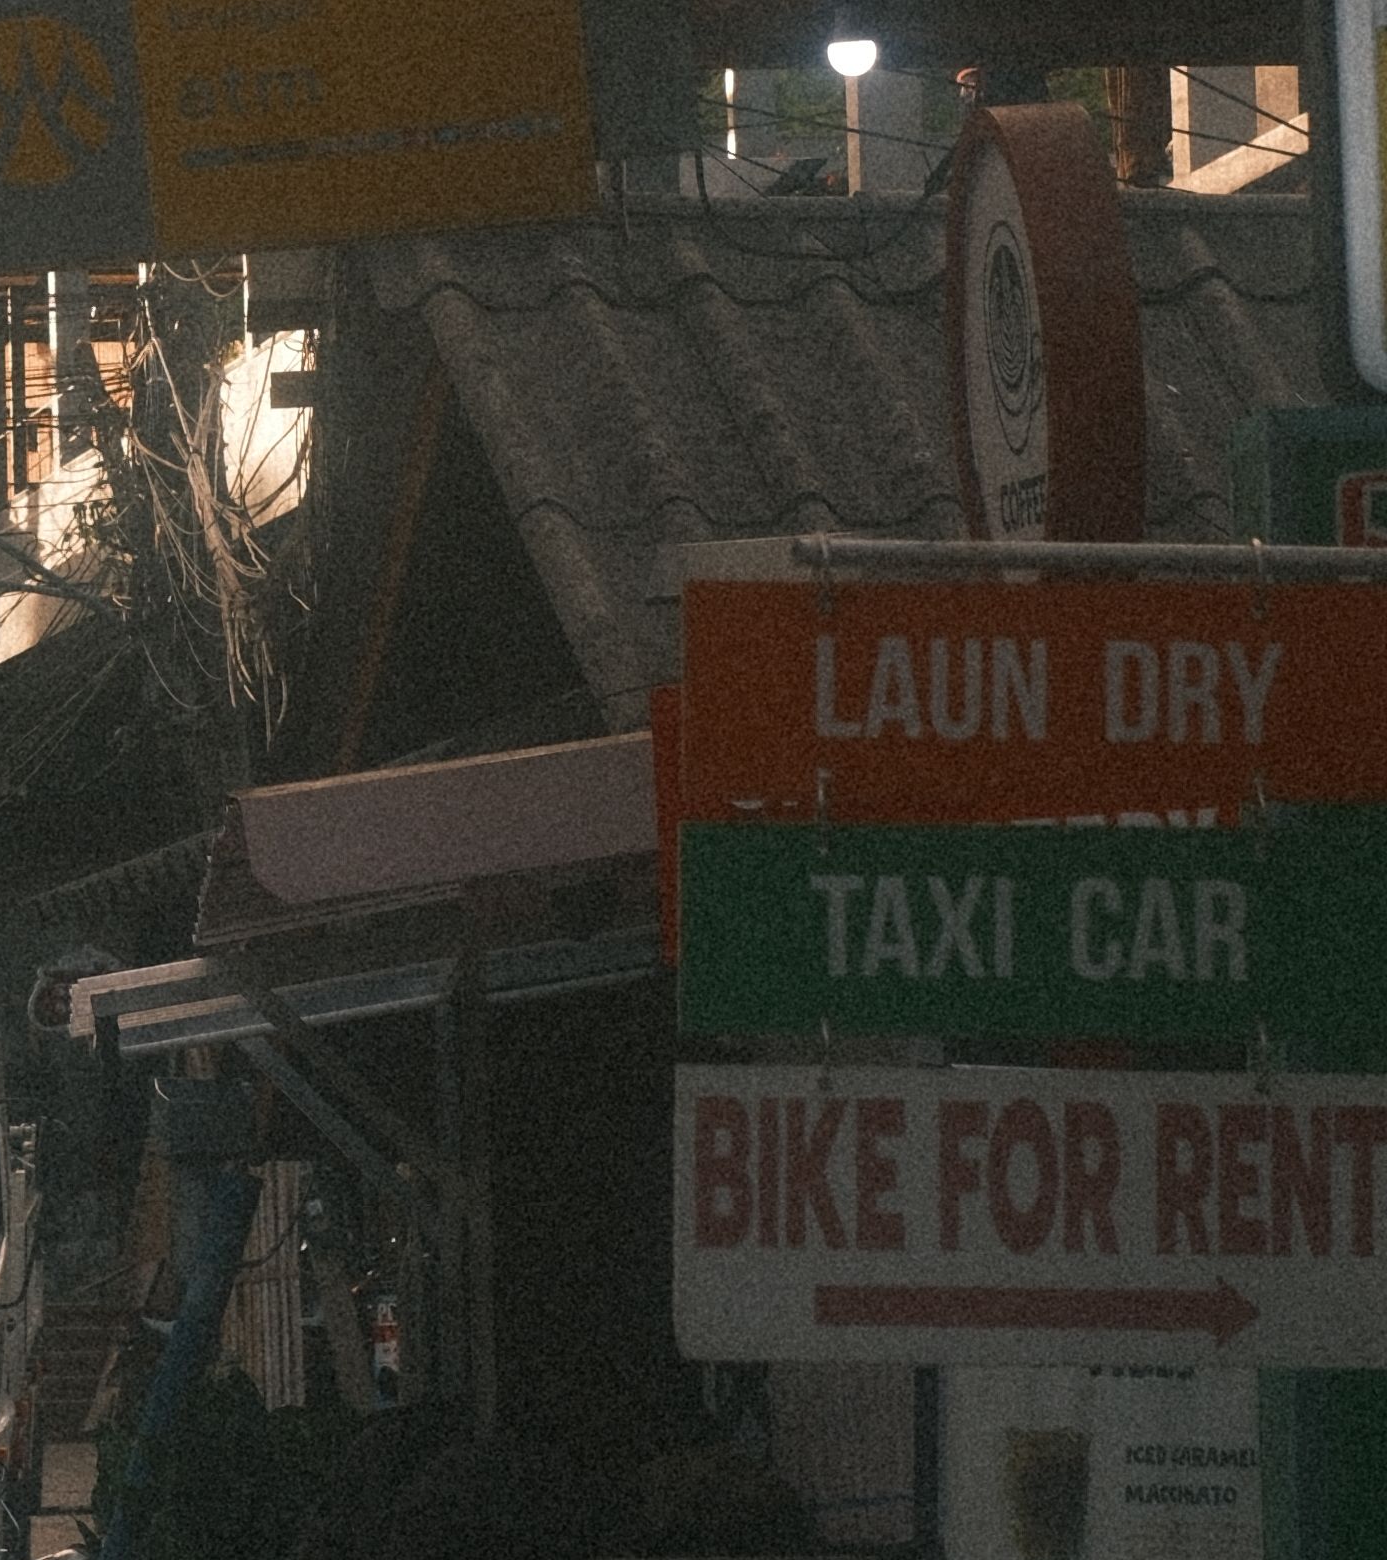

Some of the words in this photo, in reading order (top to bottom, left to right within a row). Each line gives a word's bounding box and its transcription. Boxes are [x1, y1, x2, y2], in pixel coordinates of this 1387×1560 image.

[177, 64, 325, 120] atm
[812, 635, 1047, 742] LAUN
[1105, 640, 1286, 745] DRY
[811, 875, 1015, 980] TAXI
[1069, 874, 1250, 984] CAR
[693, 1096, 908, 1251] BIKE
[937, 1099, 1122, 1256] FOR
[1156, 1104, 1387, 1257] RENT
[1125, 1445, 1168, 1467] ICED
[1171, 1446, 1257, 1469] CARAMEL
